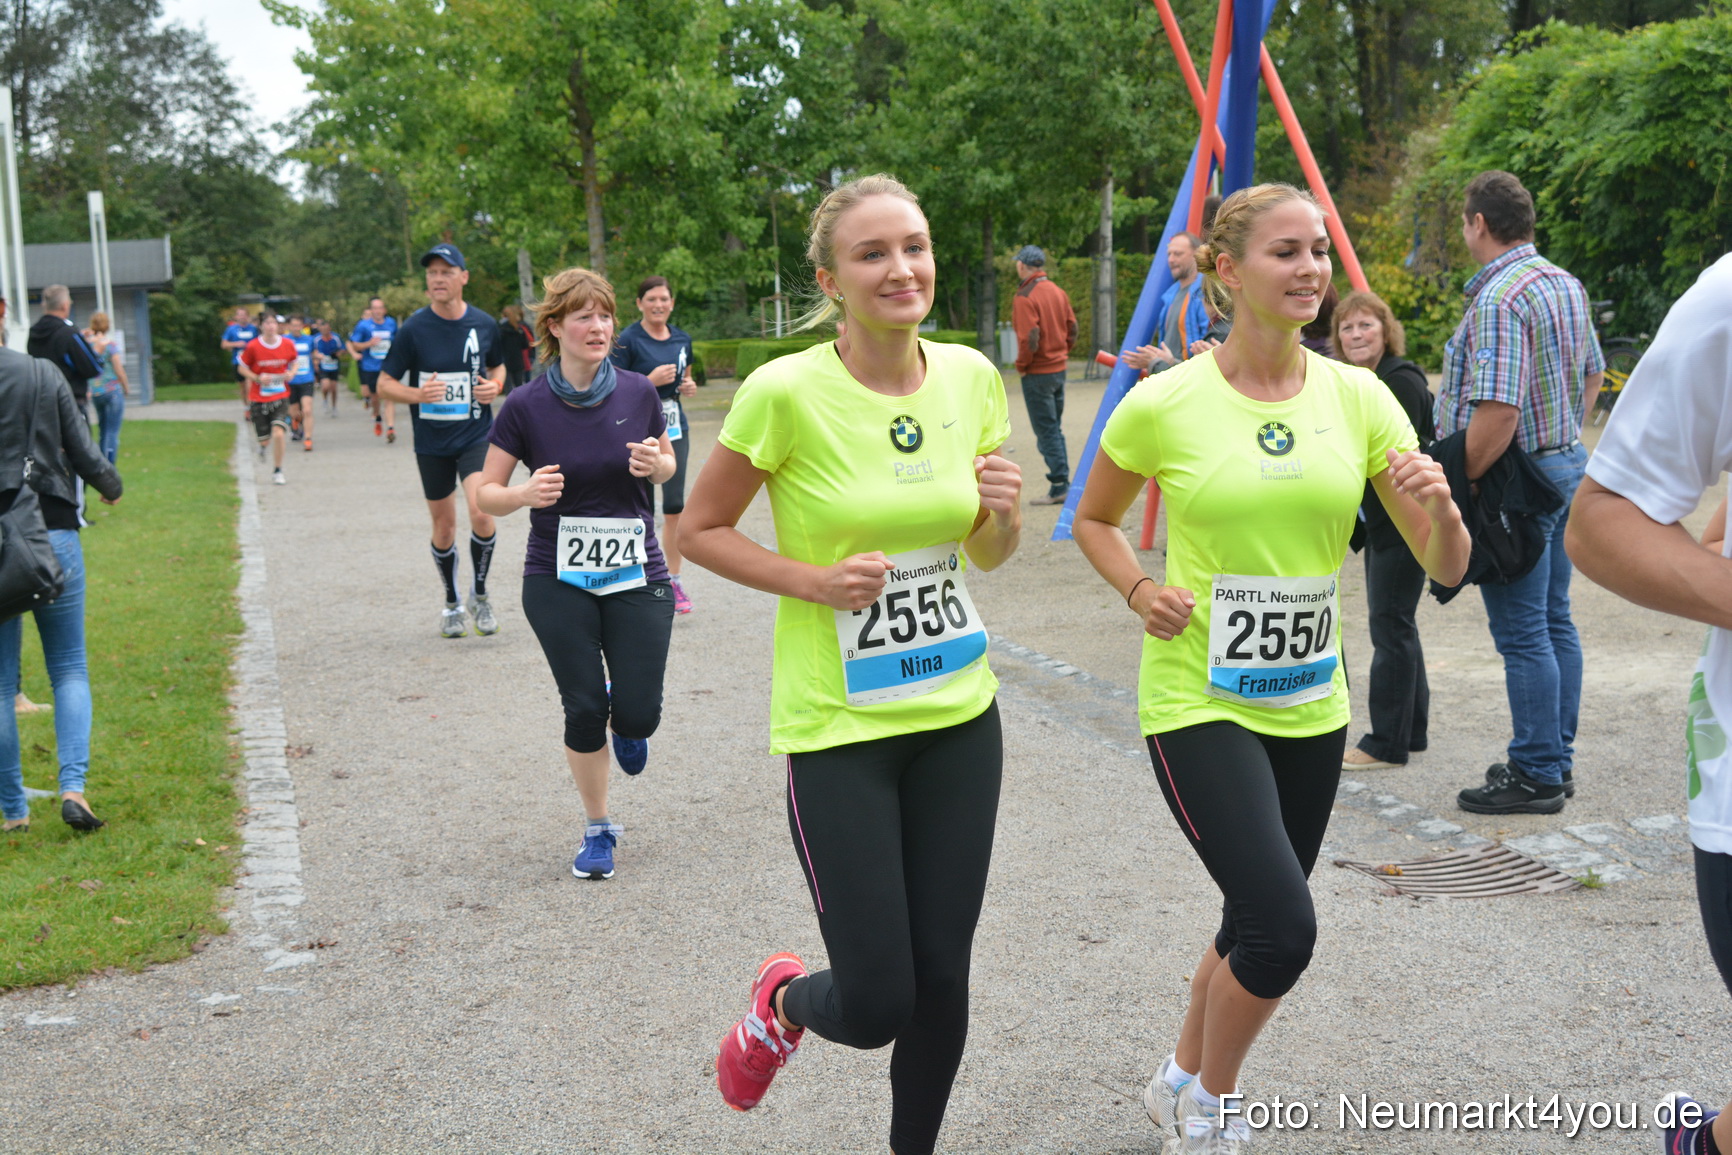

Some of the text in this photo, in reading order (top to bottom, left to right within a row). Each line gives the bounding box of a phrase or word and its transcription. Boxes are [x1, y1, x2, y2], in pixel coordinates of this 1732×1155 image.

[893, 459, 933, 477] Partl
[1260, 459, 1303, 473] Partl
[896, 474, 935, 485] Neumarkt
[1261, 473, 1303, 481] Neumarkt
[560, 525, 631, 534] PARTL Neumarkt
[568, 537, 639, 567] 2424
[584, 573, 620, 587] Teresa
[889, 560, 947, 583] Neumarkt
[1215, 588, 1330, 603] PARTL Neumarkt
[852, 579, 968, 650] 2556
[1225, 605, 1332, 661] 2550
[900, 654, 943, 678] Nina
[1238, 670, 1316, 694] Franziska
